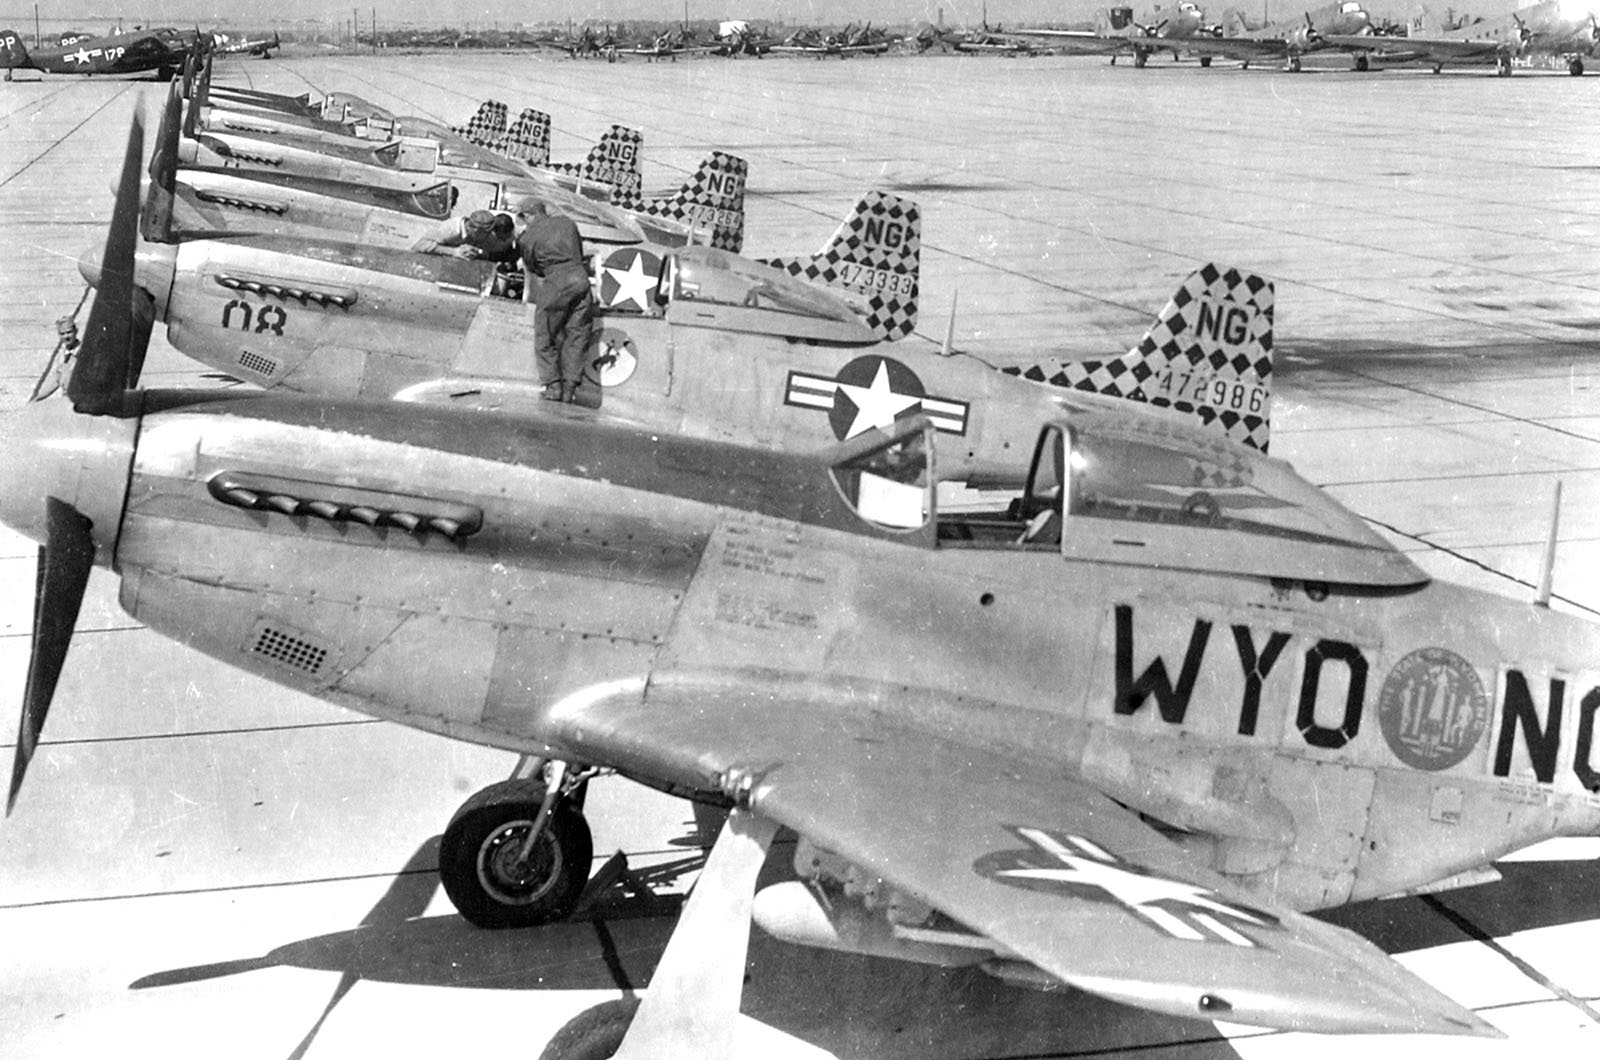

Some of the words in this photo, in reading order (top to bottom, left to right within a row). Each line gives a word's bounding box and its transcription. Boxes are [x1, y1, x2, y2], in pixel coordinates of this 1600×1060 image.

[104, 47, 125, 61] 17P
[484, 112, 501, 126] NG
[523, 122, 542, 138] NG
[608, 142, 633, 160] NG
[707, 172, 736, 195] NG
[864, 217, 903, 248] NG
[840, 264, 912, 294] 473333
[1195, 301, 1249, 346] NG
[1160, 371, 1263, 413] 472986
[1114, 603, 1369, 749] WYO
